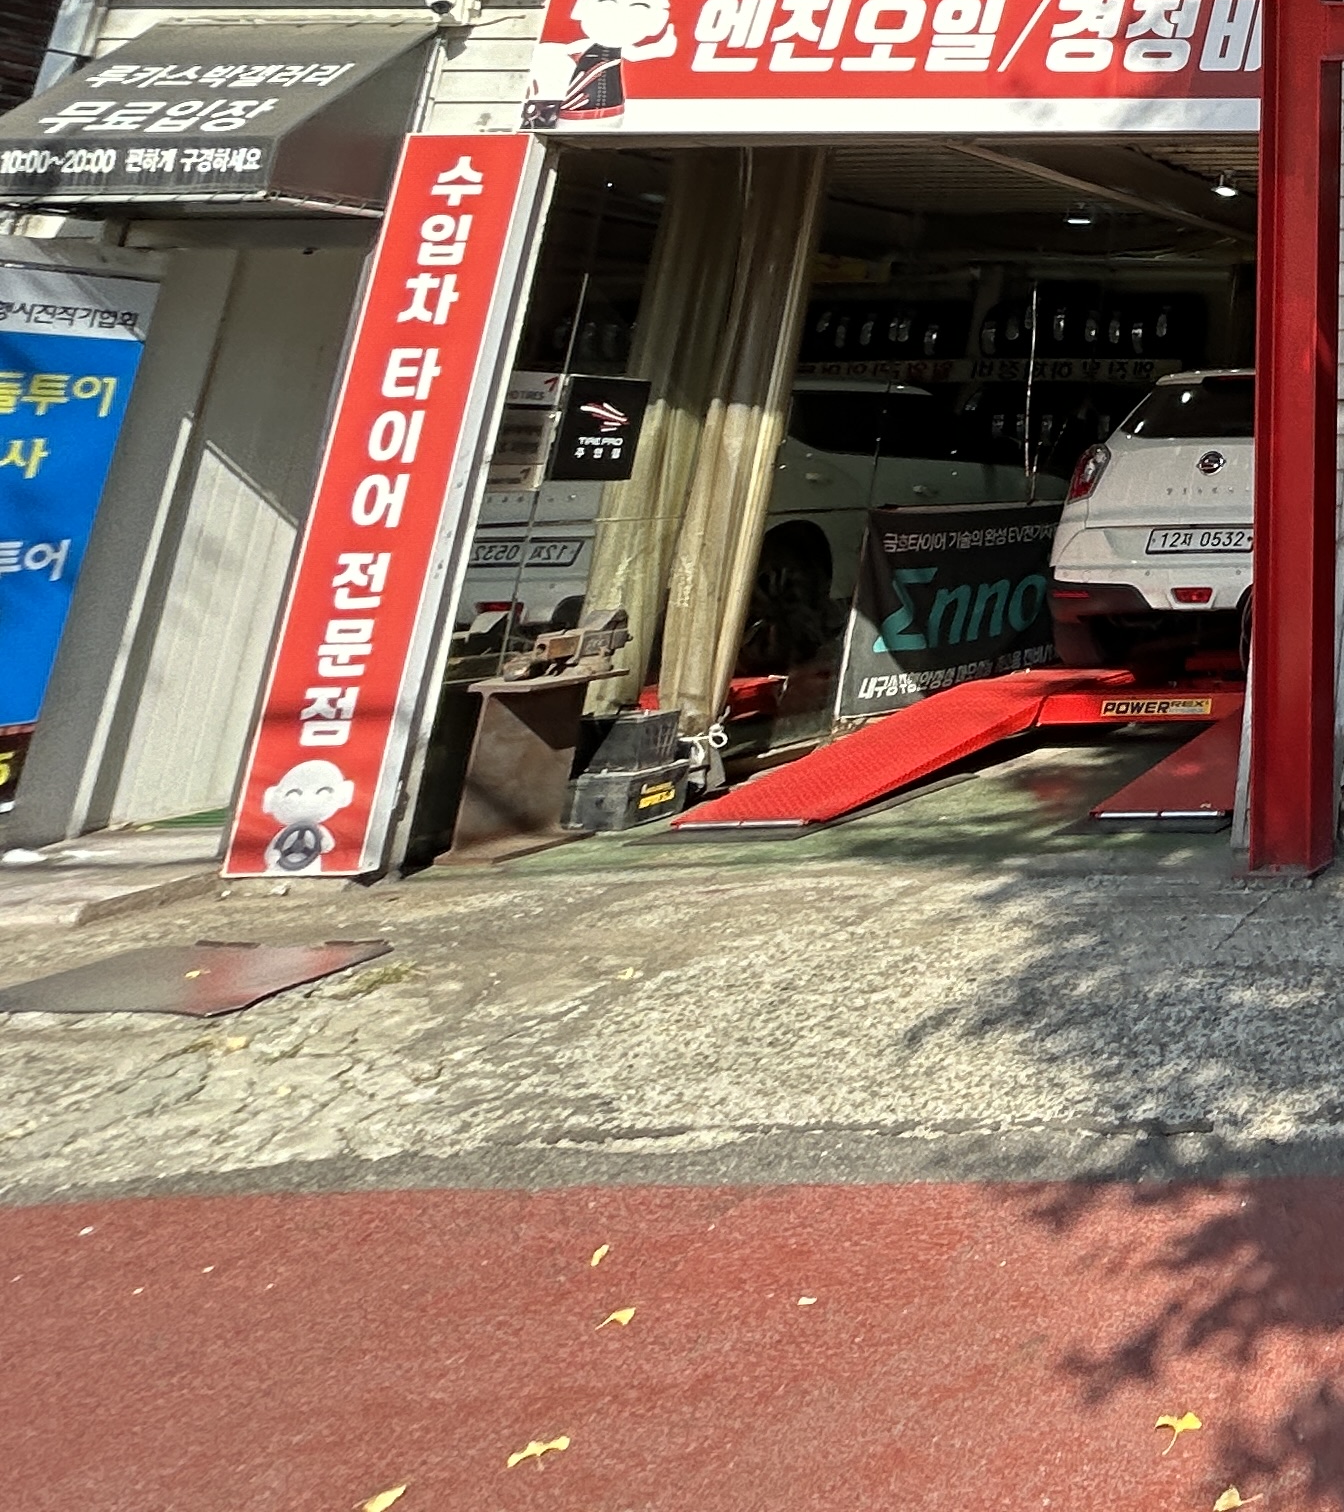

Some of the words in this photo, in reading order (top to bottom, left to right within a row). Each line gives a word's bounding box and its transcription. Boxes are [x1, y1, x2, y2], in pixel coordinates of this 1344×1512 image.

[85, 63, 355, 88] 루카스박갤러리
[38, 98, 280, 134] 무료입장
[0, 149, 117, 174] 10:00~20:00
[124, 148, 177, 173] 편하게
[180, 148, 264, 173] 구경하세요
[397, 155, 483, 325] 수입차
[352, 347, 441, 528] 타이어
[1199, 531, 1245, 547] 0532
[301, 551, 391, 746] 전문점
